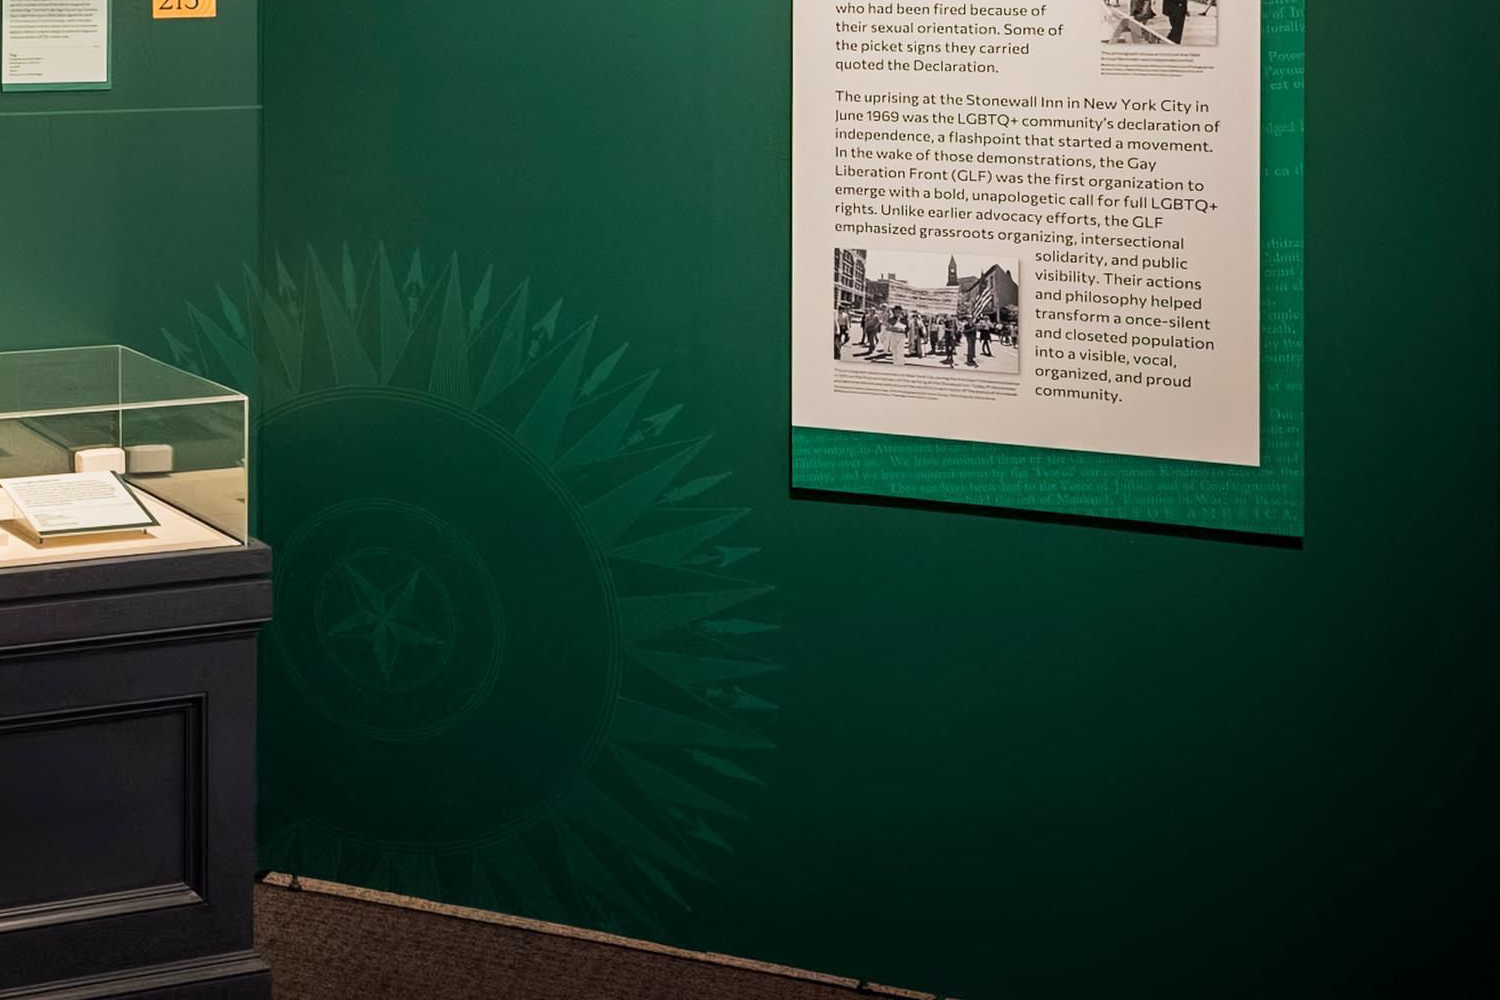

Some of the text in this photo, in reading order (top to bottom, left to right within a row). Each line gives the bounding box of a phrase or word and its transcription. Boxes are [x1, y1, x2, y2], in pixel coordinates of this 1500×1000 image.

[835, 20, 1064, 37] their sexual orientation. Some of
[835, 58, 999, 74] quoted the Declaration.
[834, 90, 1210, 116] The uprising at the Stonewall Inn in New York City in
[835, 109, 864, 123] June
[866, 110, 900, 123] 1969
[902, 114, 930, 124] was
[932, 111, 955, 125] the
[957, 112, 1019, 129] LGBTQ+
[1117, 117, 1201, 133] declaration
[1203, 120, 1221, 134] of
[835, 146, 1157, 173] In the wake of those demonstrations, the Gay
[834, 201, 1164, 229] rights. Unlike earlier advocacy efforts, the GLF
[834, 221, 1184, 250] emphasized grassroots organizing, intersectional
[1034, 289, 1202, 312] and philosophy helped
